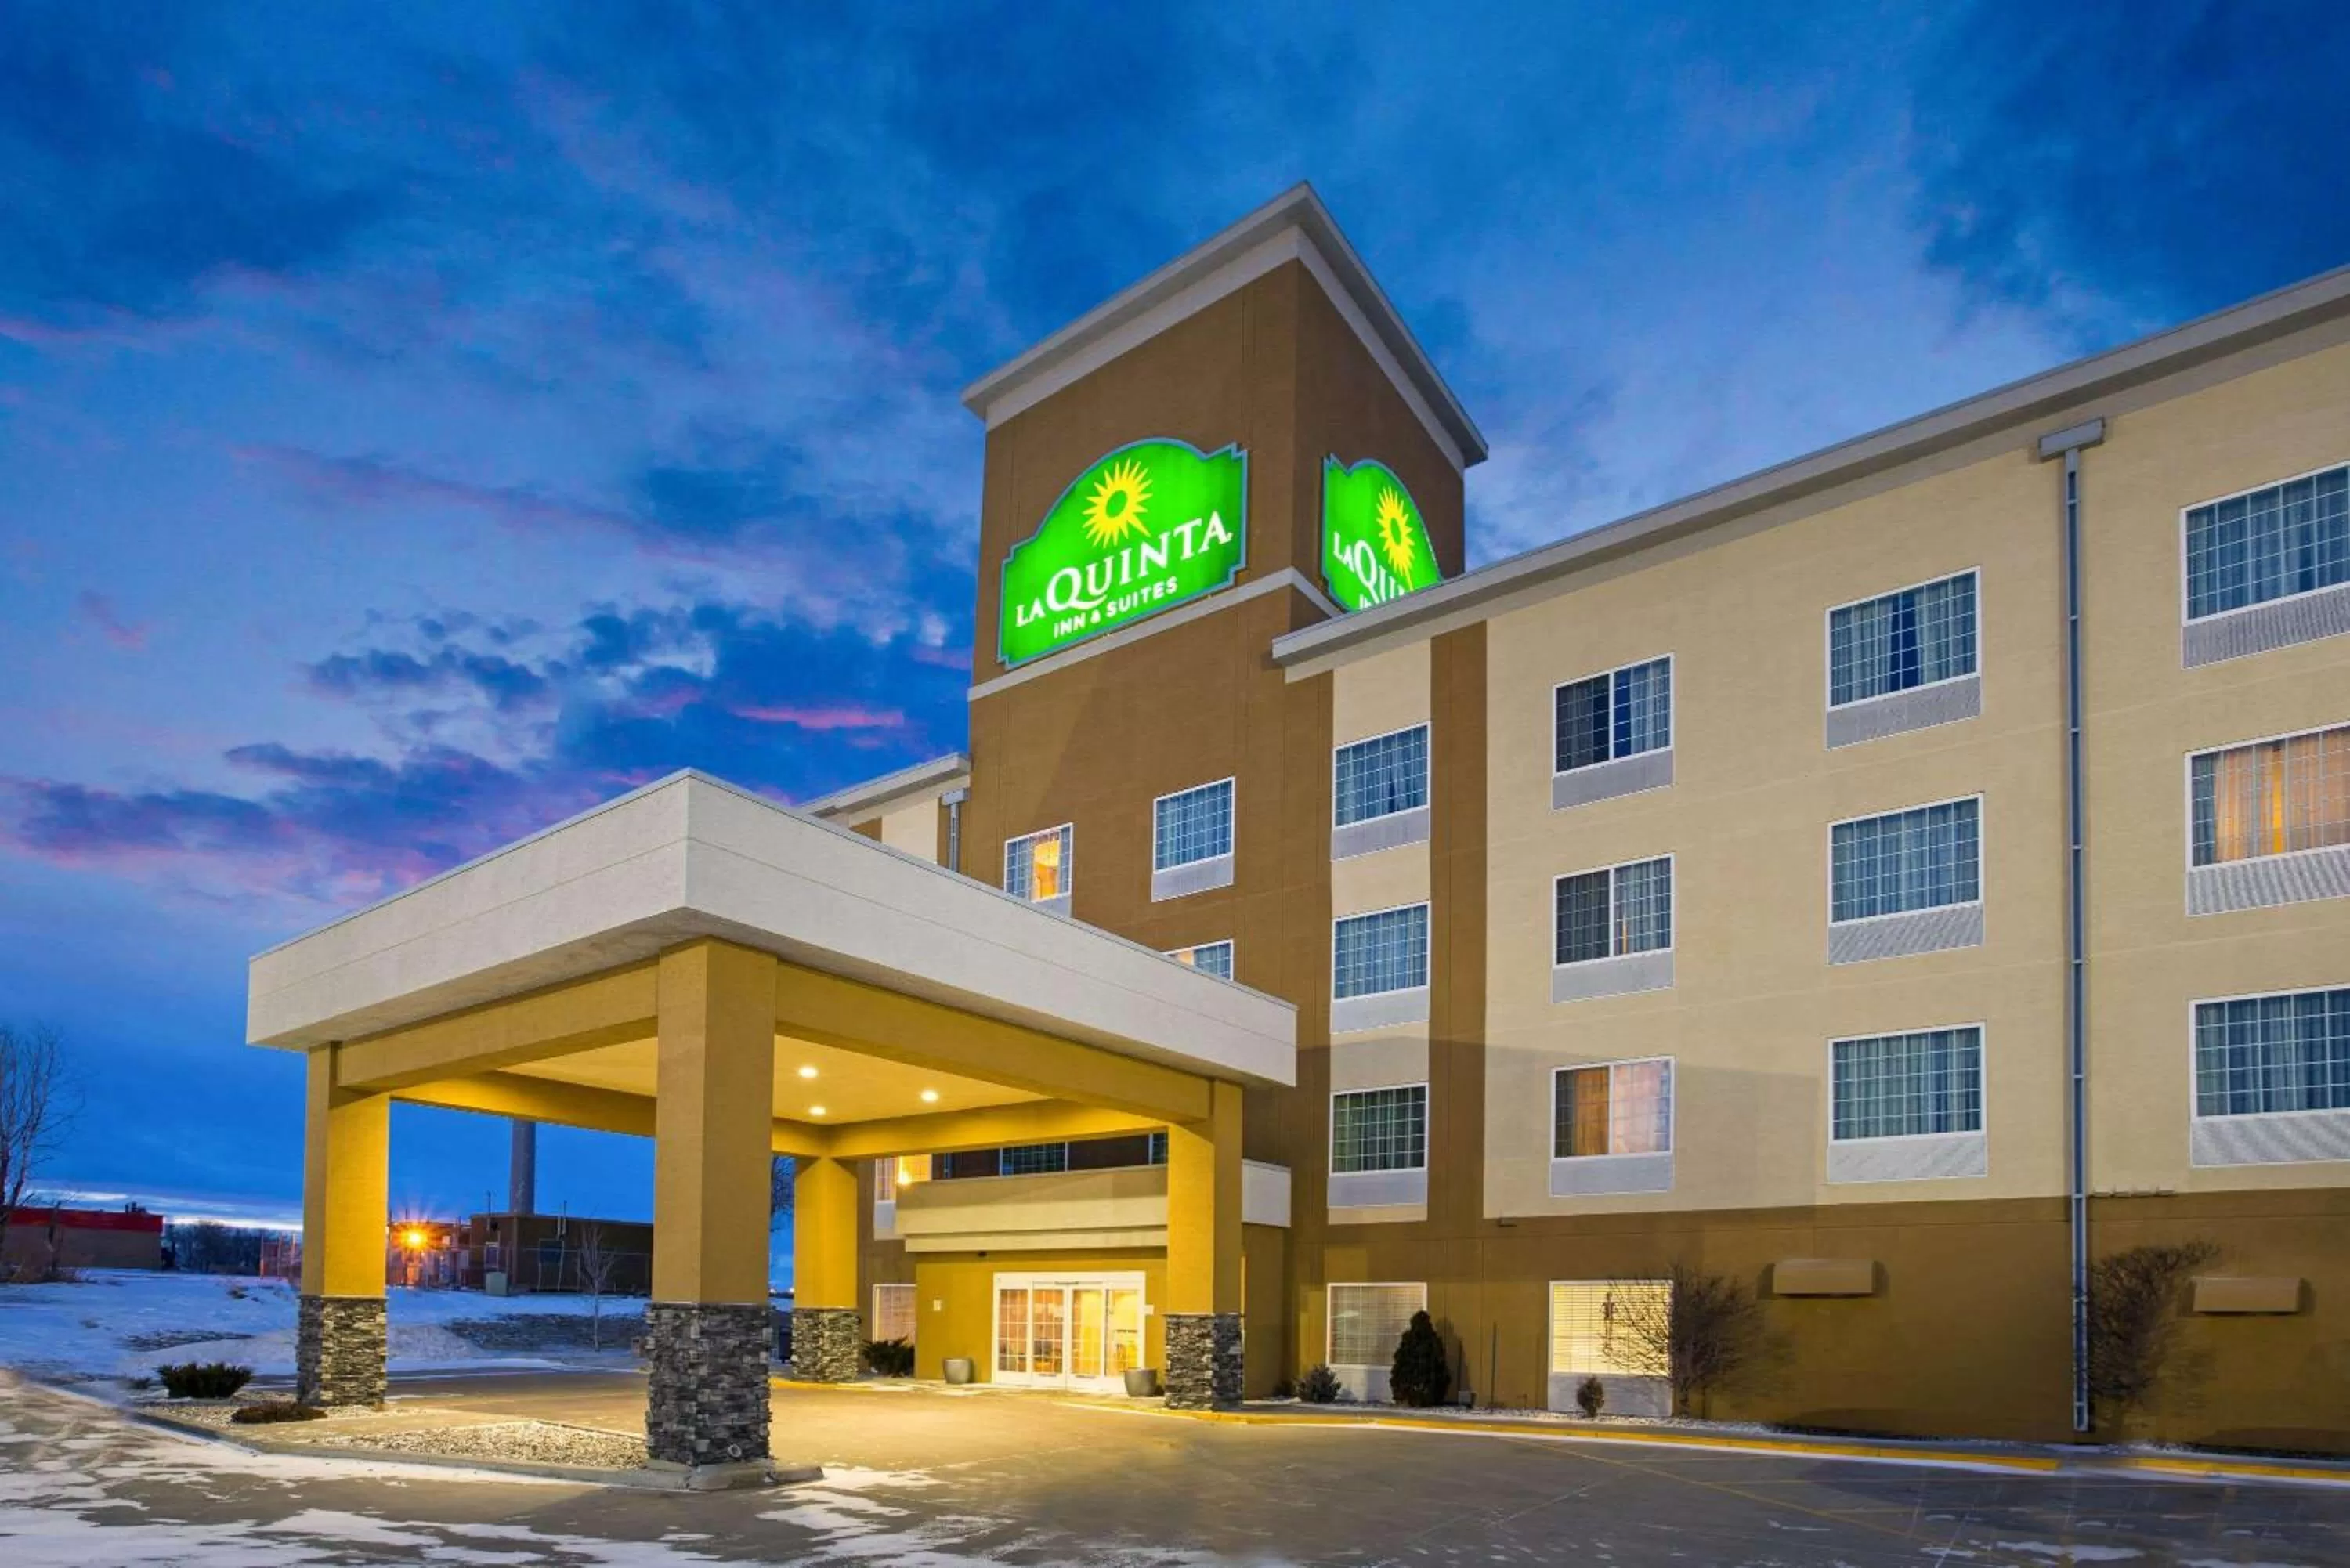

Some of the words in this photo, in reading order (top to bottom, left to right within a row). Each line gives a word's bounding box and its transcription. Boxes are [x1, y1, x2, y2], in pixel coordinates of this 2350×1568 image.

[1016, 598, 1046, 627] LA
[1046, 511, 1233, 612] QUINTA
[1333, 532, 1354, 573] LA
[1054, 612, 1086, 638] INN
[1090, 610, 1101, 624] &
[1106, 576, 1178, 618] SUITES
